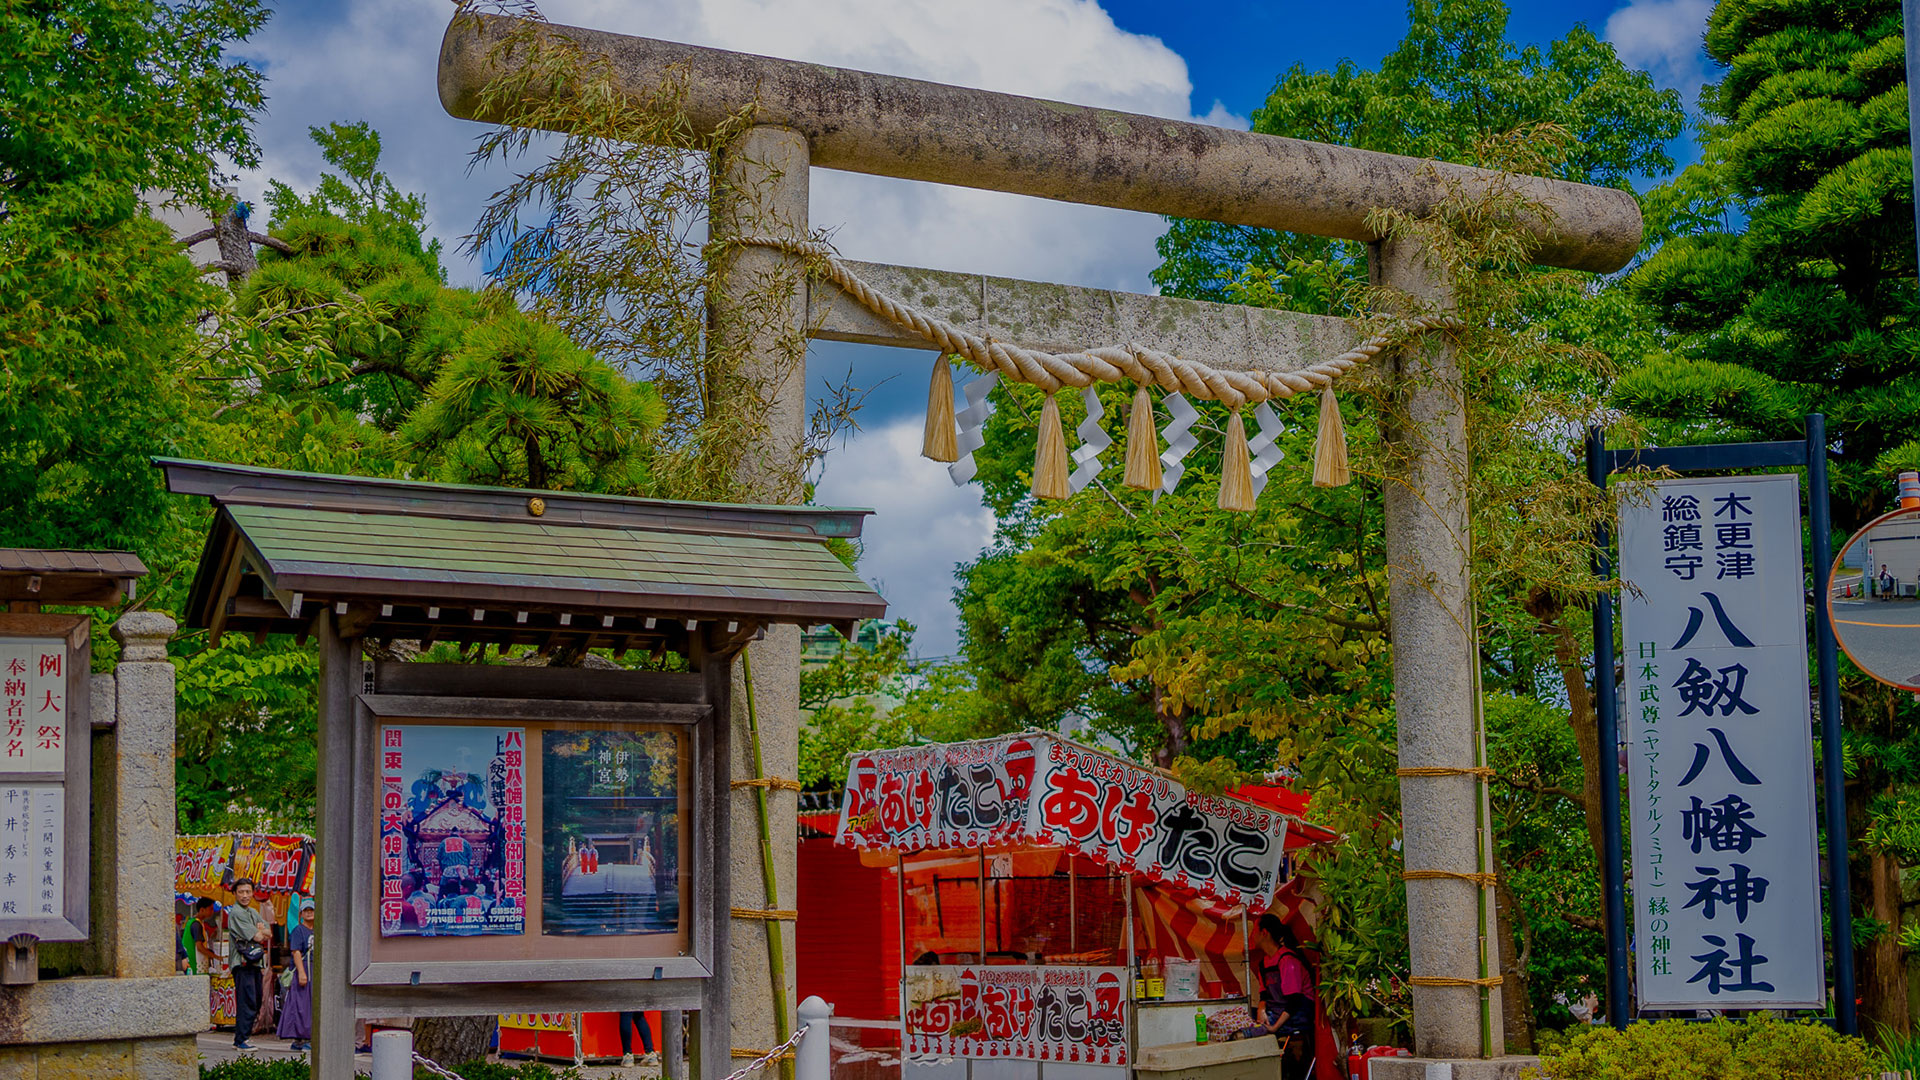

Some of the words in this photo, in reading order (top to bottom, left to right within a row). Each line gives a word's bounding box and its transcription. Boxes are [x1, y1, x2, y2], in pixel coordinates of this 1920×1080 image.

[1662, 495, 1704, 580] 総鎮守
[1713, 492, 1756, 580] 木更津
[4, 657, 26, 757] 奉納者芳名
[37, 653, 62, 750] 例大祭
[616, 751, 629, 782] 伊勢
[384, 729, 402, 921] 関東一の大神輿巡行
[1040, 766, 1269, 893] あげたこ
